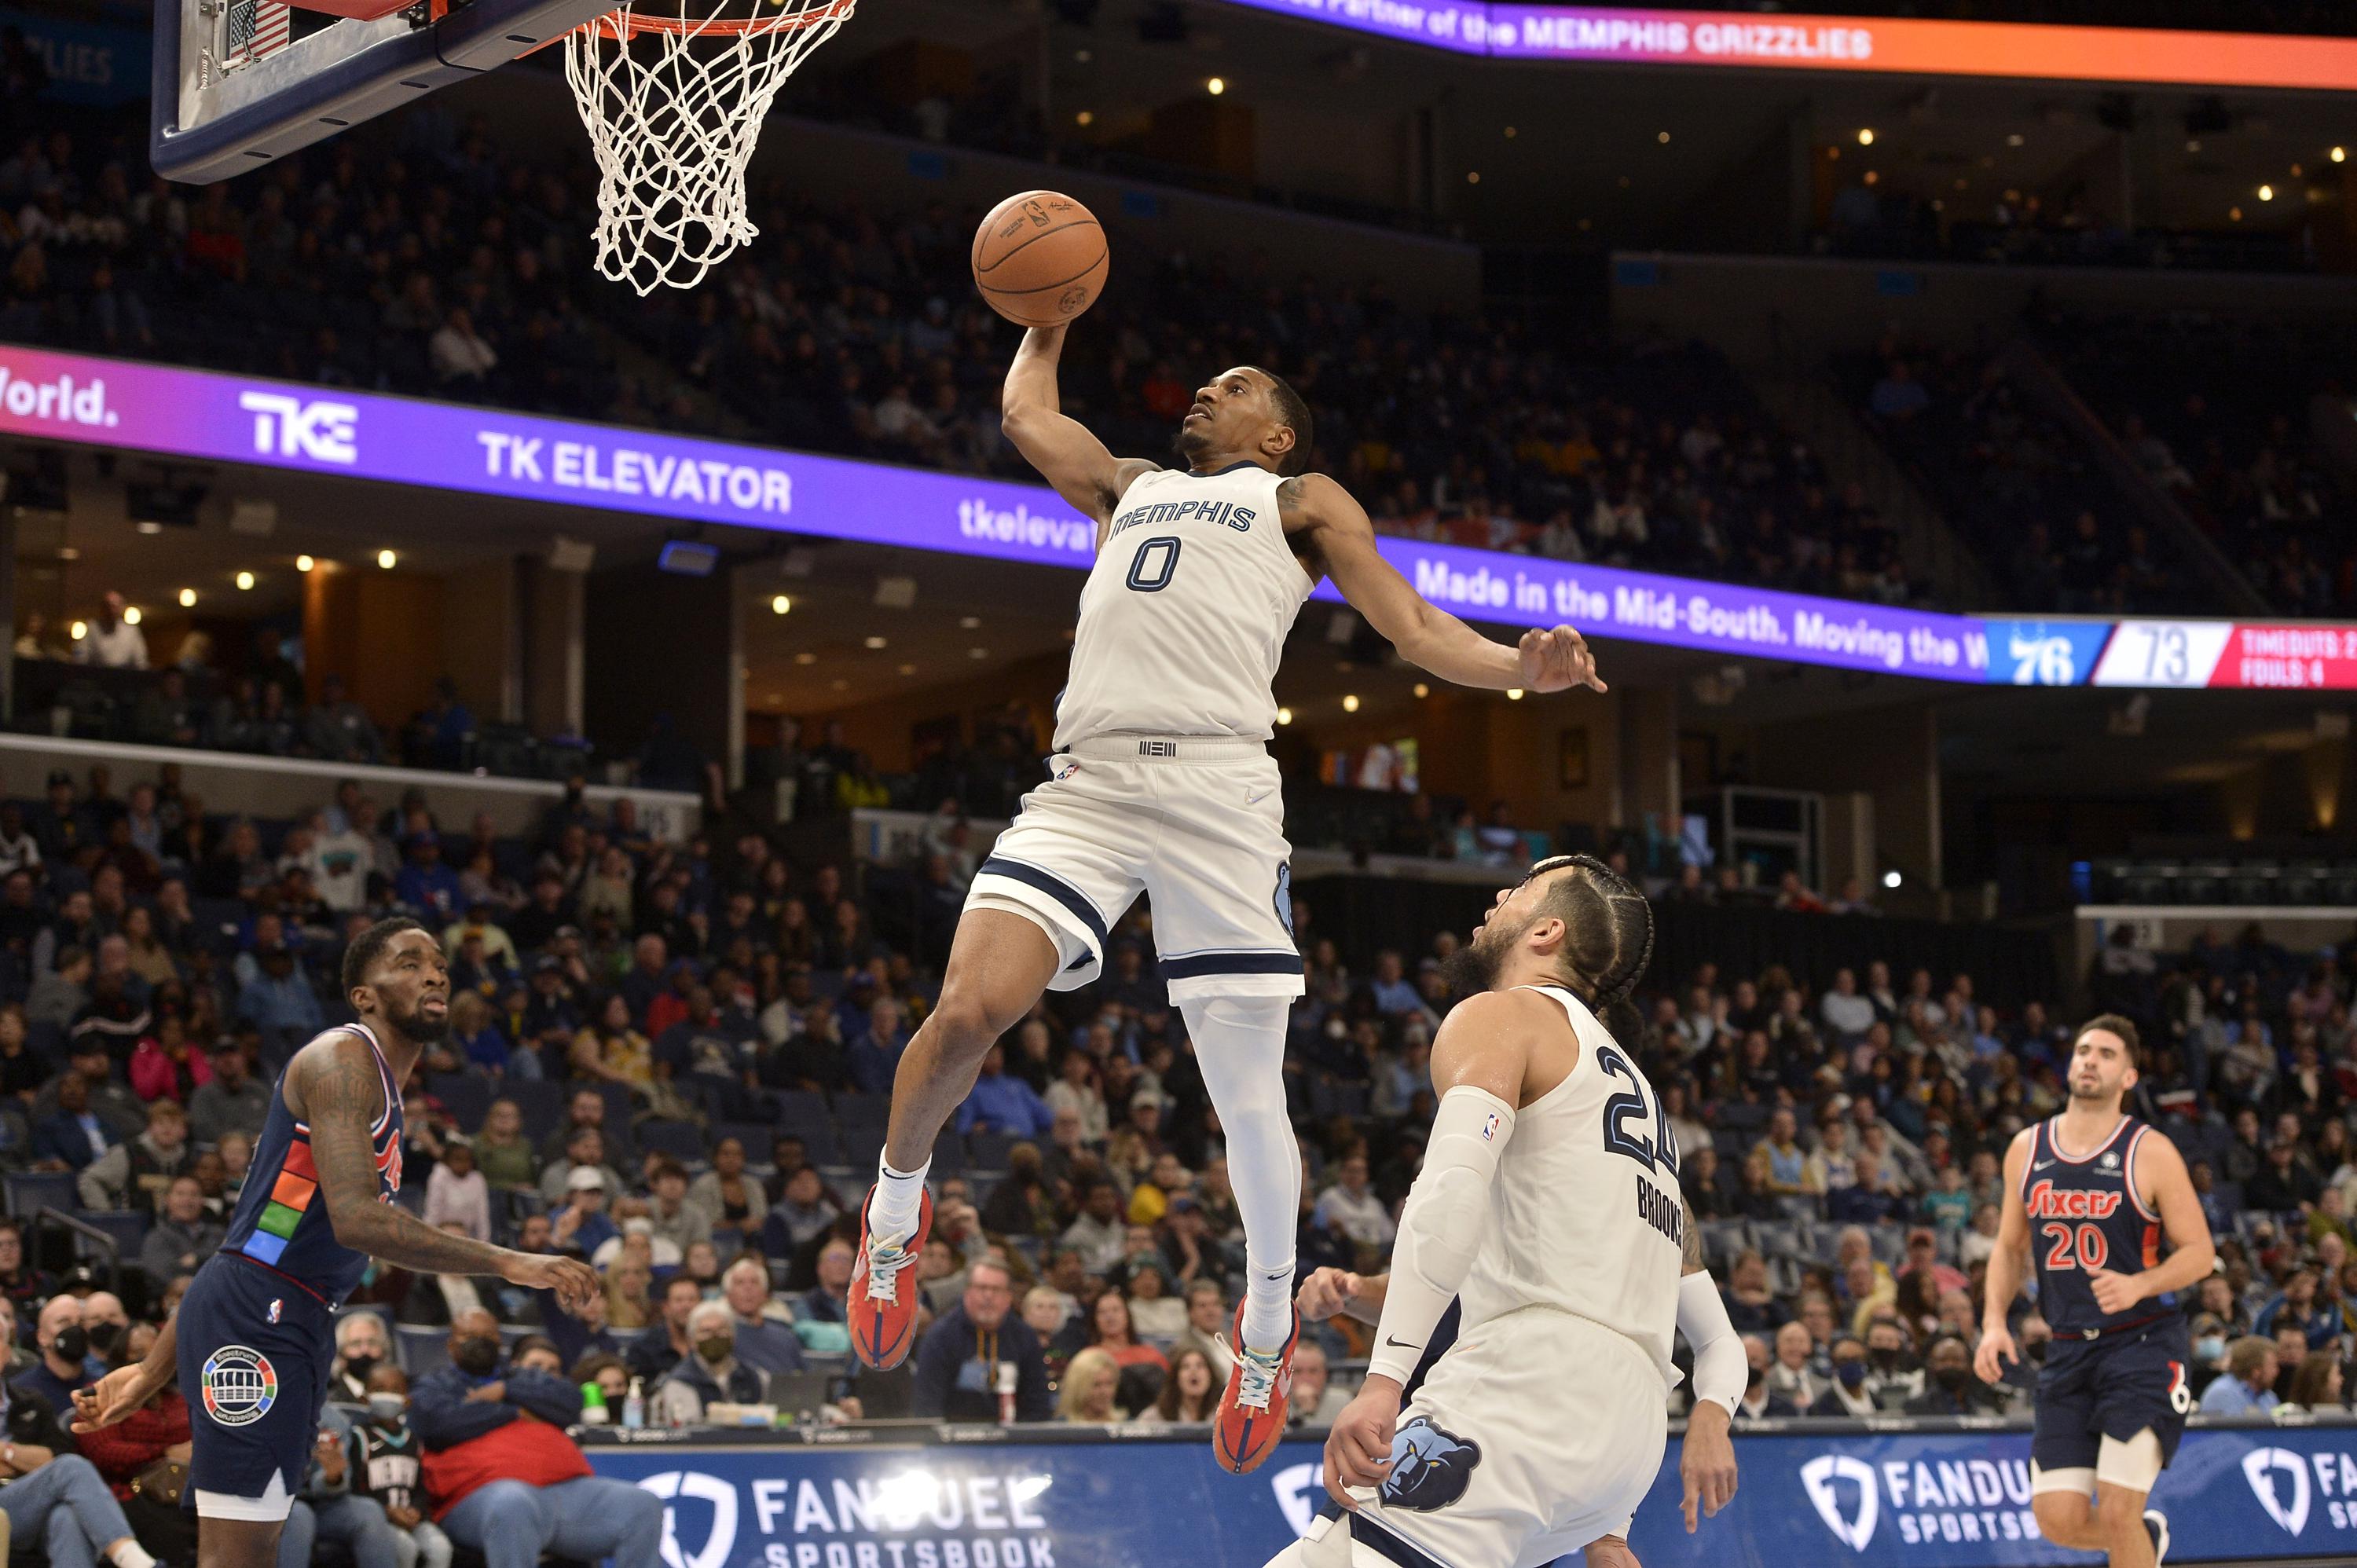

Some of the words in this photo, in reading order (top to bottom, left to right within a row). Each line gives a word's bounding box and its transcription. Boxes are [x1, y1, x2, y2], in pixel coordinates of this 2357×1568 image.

[1428, 9, 1459, 38] of
[1461, 13, 1518, 48] the
[1523, 16, 1689, 54] MEMPHIS
[1694, 24, 1873, 60] GRIZZLIES
[240, 391, 358, 464] TKE
[476, 431, 544, 482] TK
[552, 441, 793, 514] ELEVATOR
[1110, 500, 1257, 541] MEMPHIS
[1125, 535, 1182, 592] 0
[1415, 558, 1509, 609] Made
[1515, 571, 1548, 613] in
[1552, 579, 1609, 622] the
[1614, 585, 1789, 646] Mid-South.
[1793, 609, 1904, 669] Moving
[1908, 626, 1960, 667] the
[2009, 636, 2073, 686] 76
[2136, 627, 2190, 685] 73
[2242, 628, 2344, 658] TIMEOUTS:
[2241, 657, 2309, 687] FOULS:
[2025, 1178, 2123, 1219] Sixers
[2041, 1221, 2109, 1271] 20
[764, 1537, 1057, 1568] SPORTSBOOK
